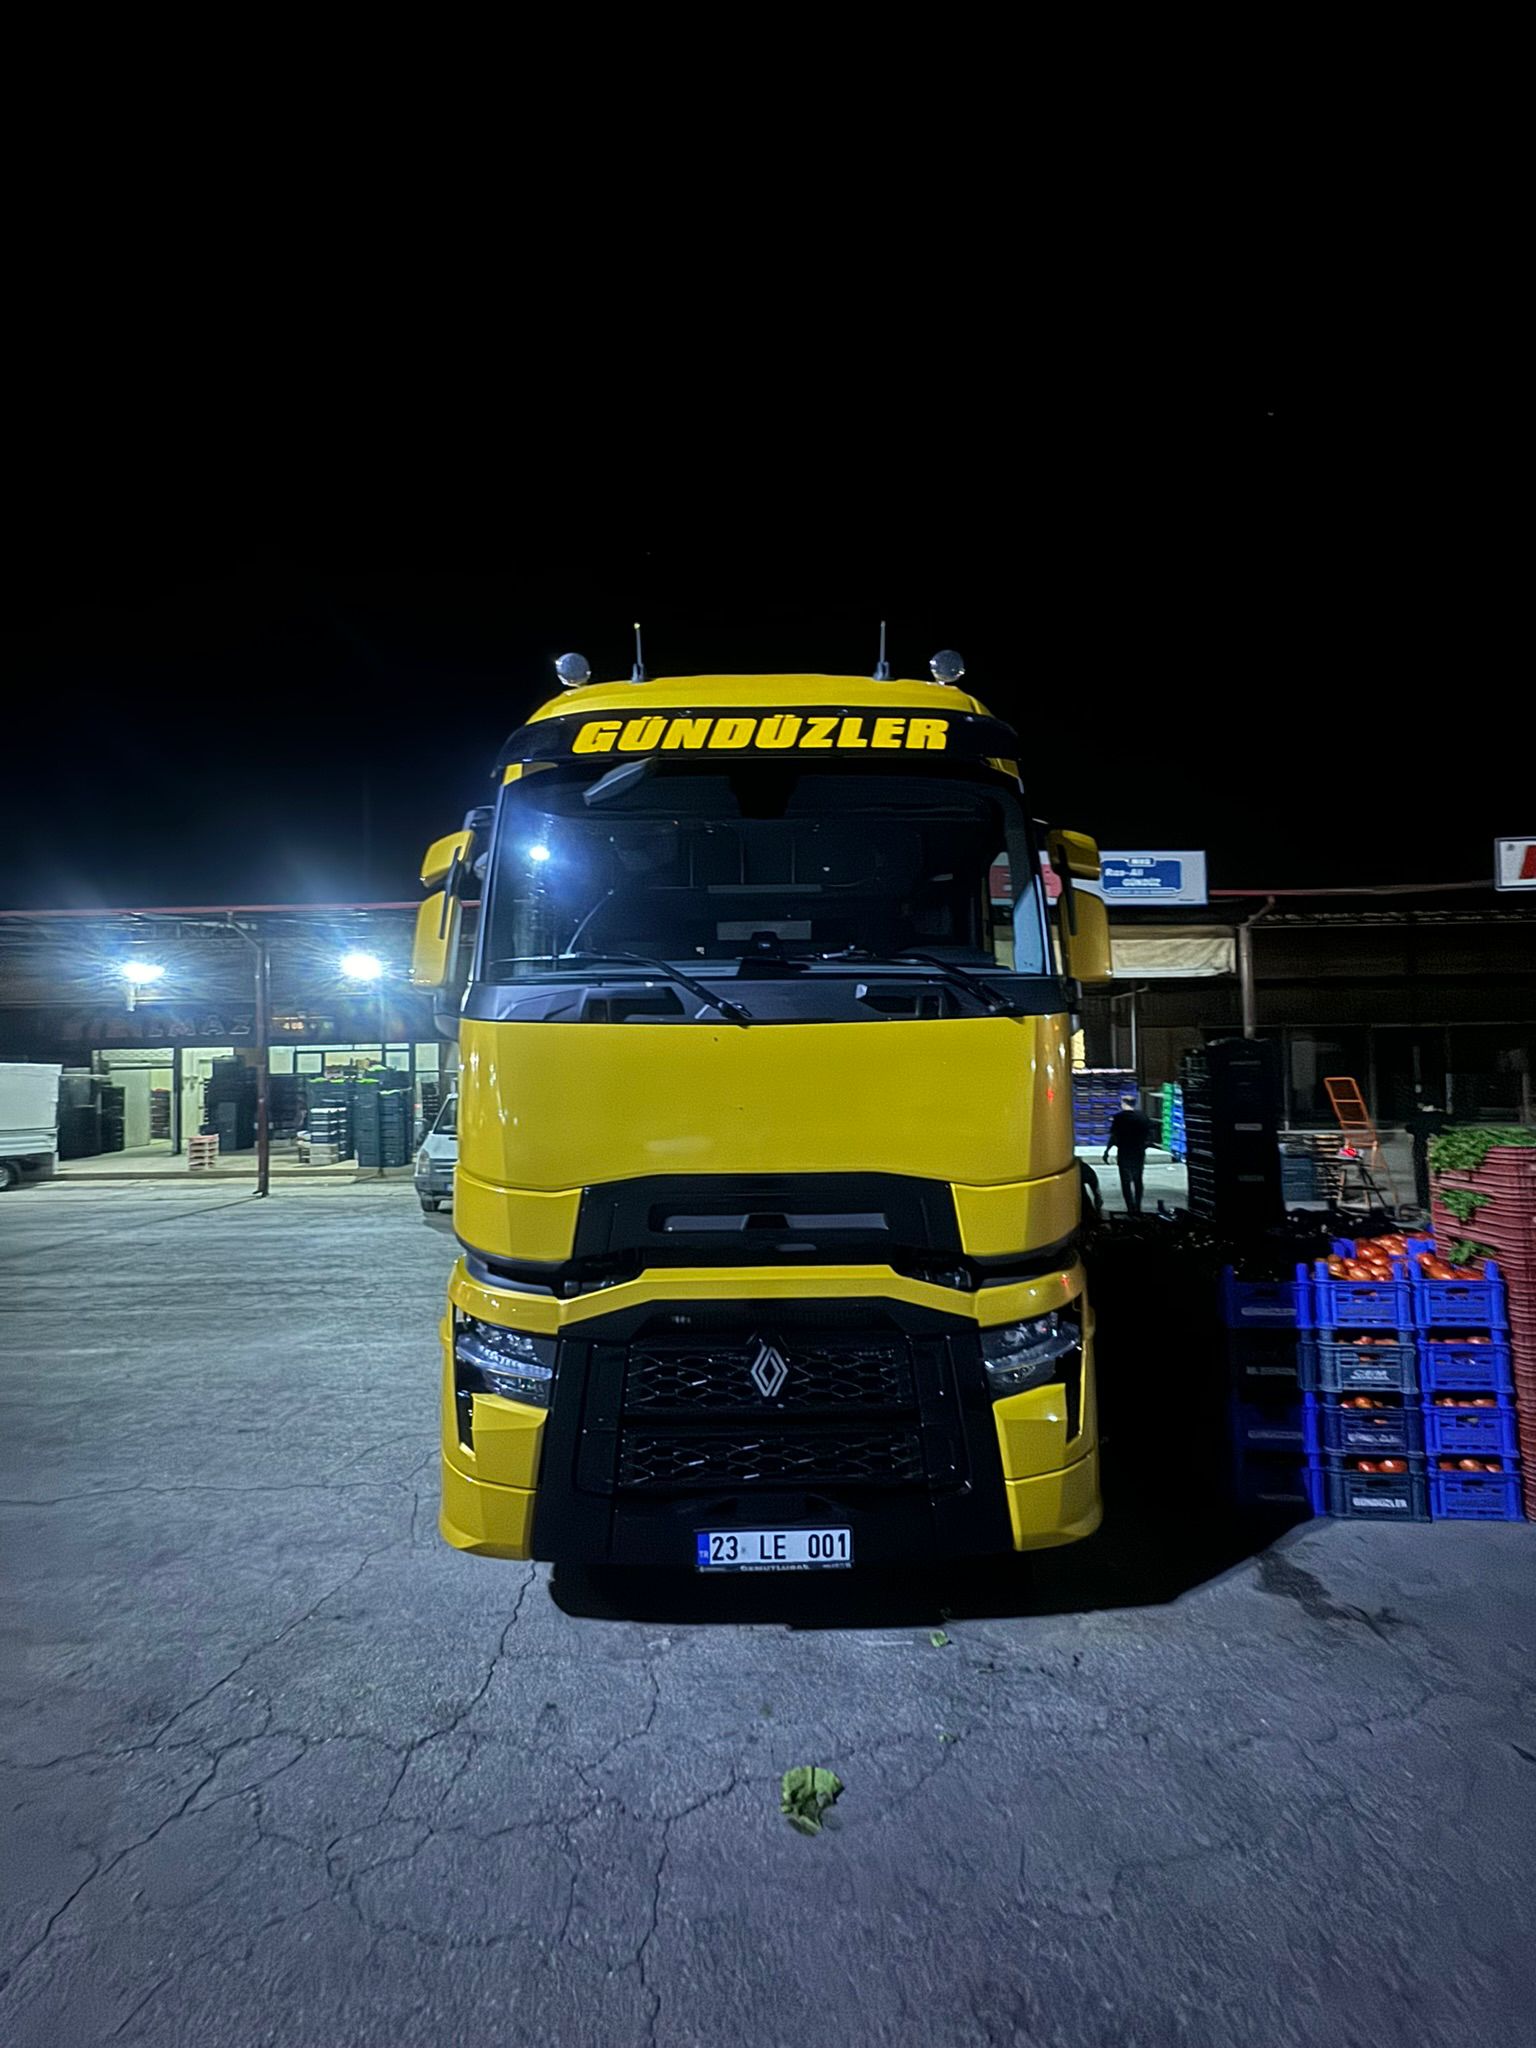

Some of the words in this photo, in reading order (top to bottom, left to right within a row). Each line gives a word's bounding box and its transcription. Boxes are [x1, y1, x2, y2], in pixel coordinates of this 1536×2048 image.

[571, 714, 949, 755] GÜNDÜZLER
[711, 1536, 739, 1561] 23
[759, 1534, 787, 1560] LE
[808, 1533, 846, 1559] 001
